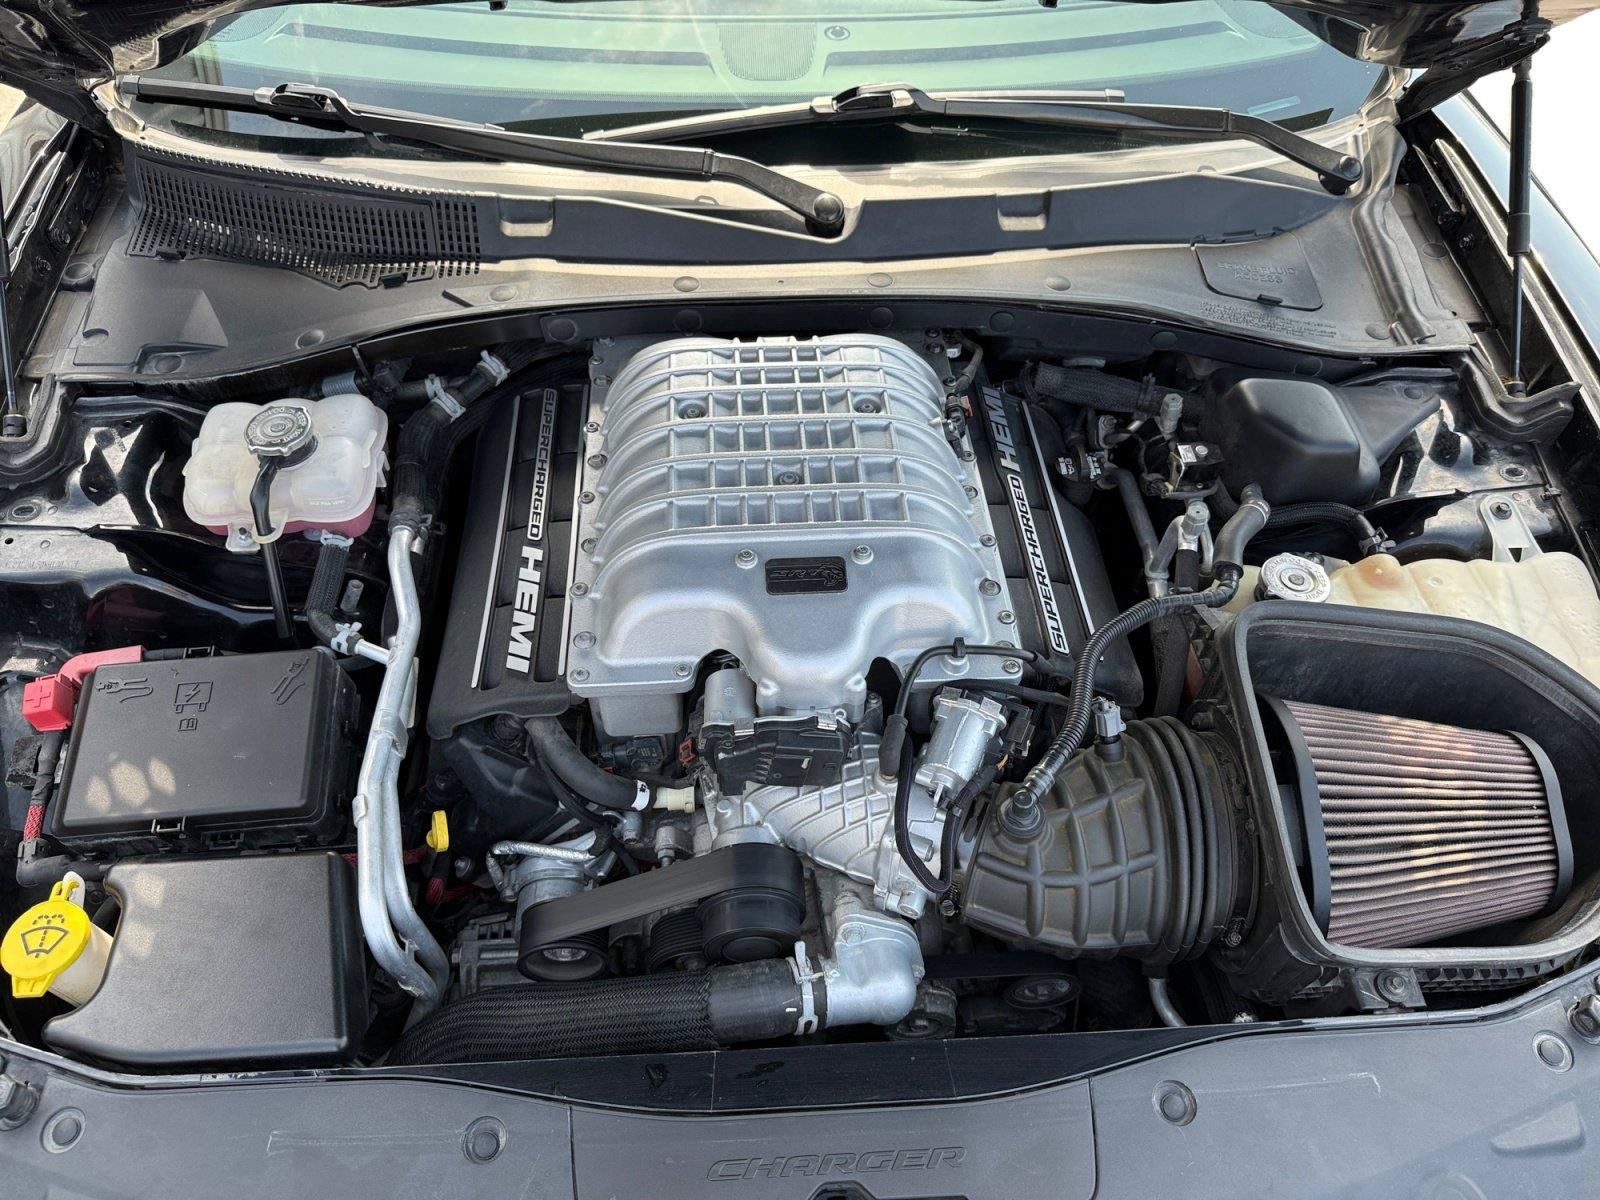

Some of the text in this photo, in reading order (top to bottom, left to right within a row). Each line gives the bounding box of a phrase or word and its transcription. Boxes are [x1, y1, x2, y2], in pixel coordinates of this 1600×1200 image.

[506, 389, 557, 673] SUPERCHARGED HEMI
[982, 385, 1069, 655] SUPERCHARGED HEMI
[706, 1146, 966, 1181] CHARGER
